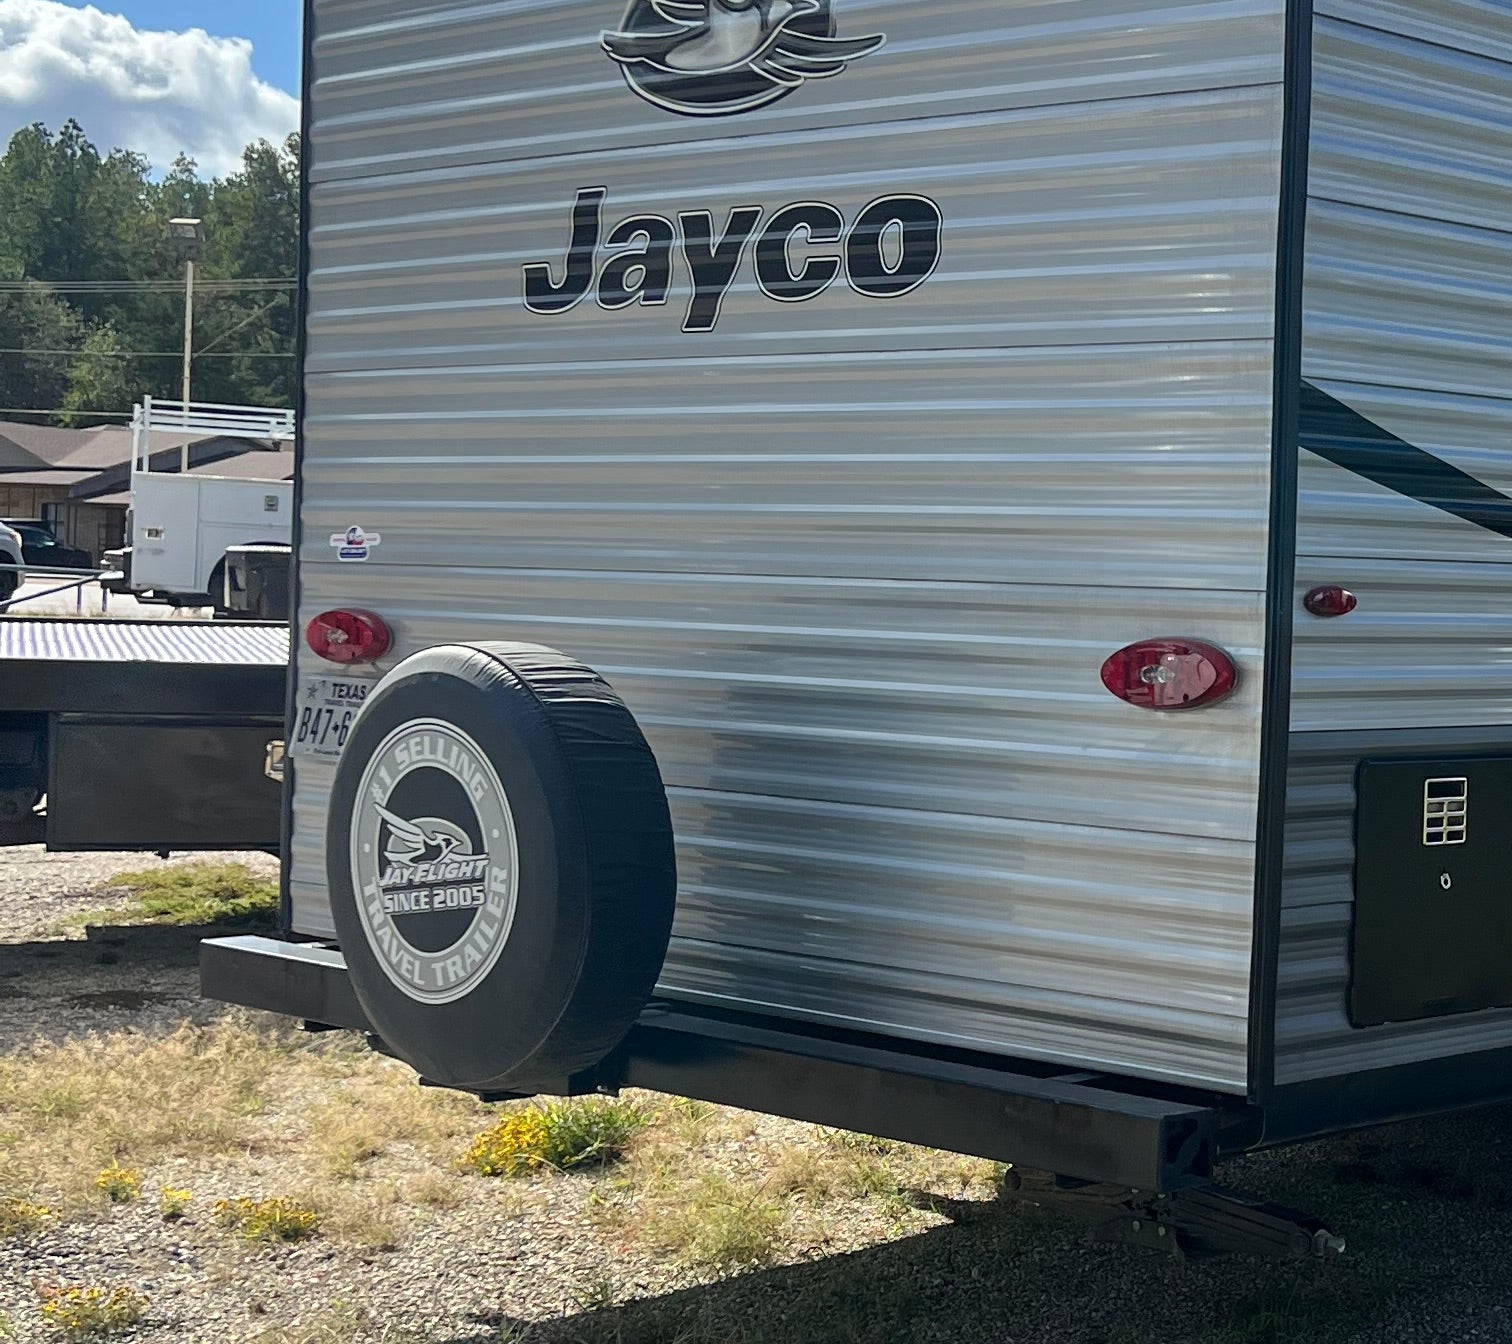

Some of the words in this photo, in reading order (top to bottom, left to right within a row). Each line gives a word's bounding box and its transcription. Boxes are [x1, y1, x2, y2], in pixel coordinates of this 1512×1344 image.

[522, 185, 943, 333] Jayco
[332, 682, 367, 701] TEXAS
[394, 735, 489, 803] SELLING
[363, 876, 426, 986] TRAVEL
[431, 866, 508, 987] TRAILER
[384, 890, 431, 913] SINCE
[433, 885, 486, 907] 2005
